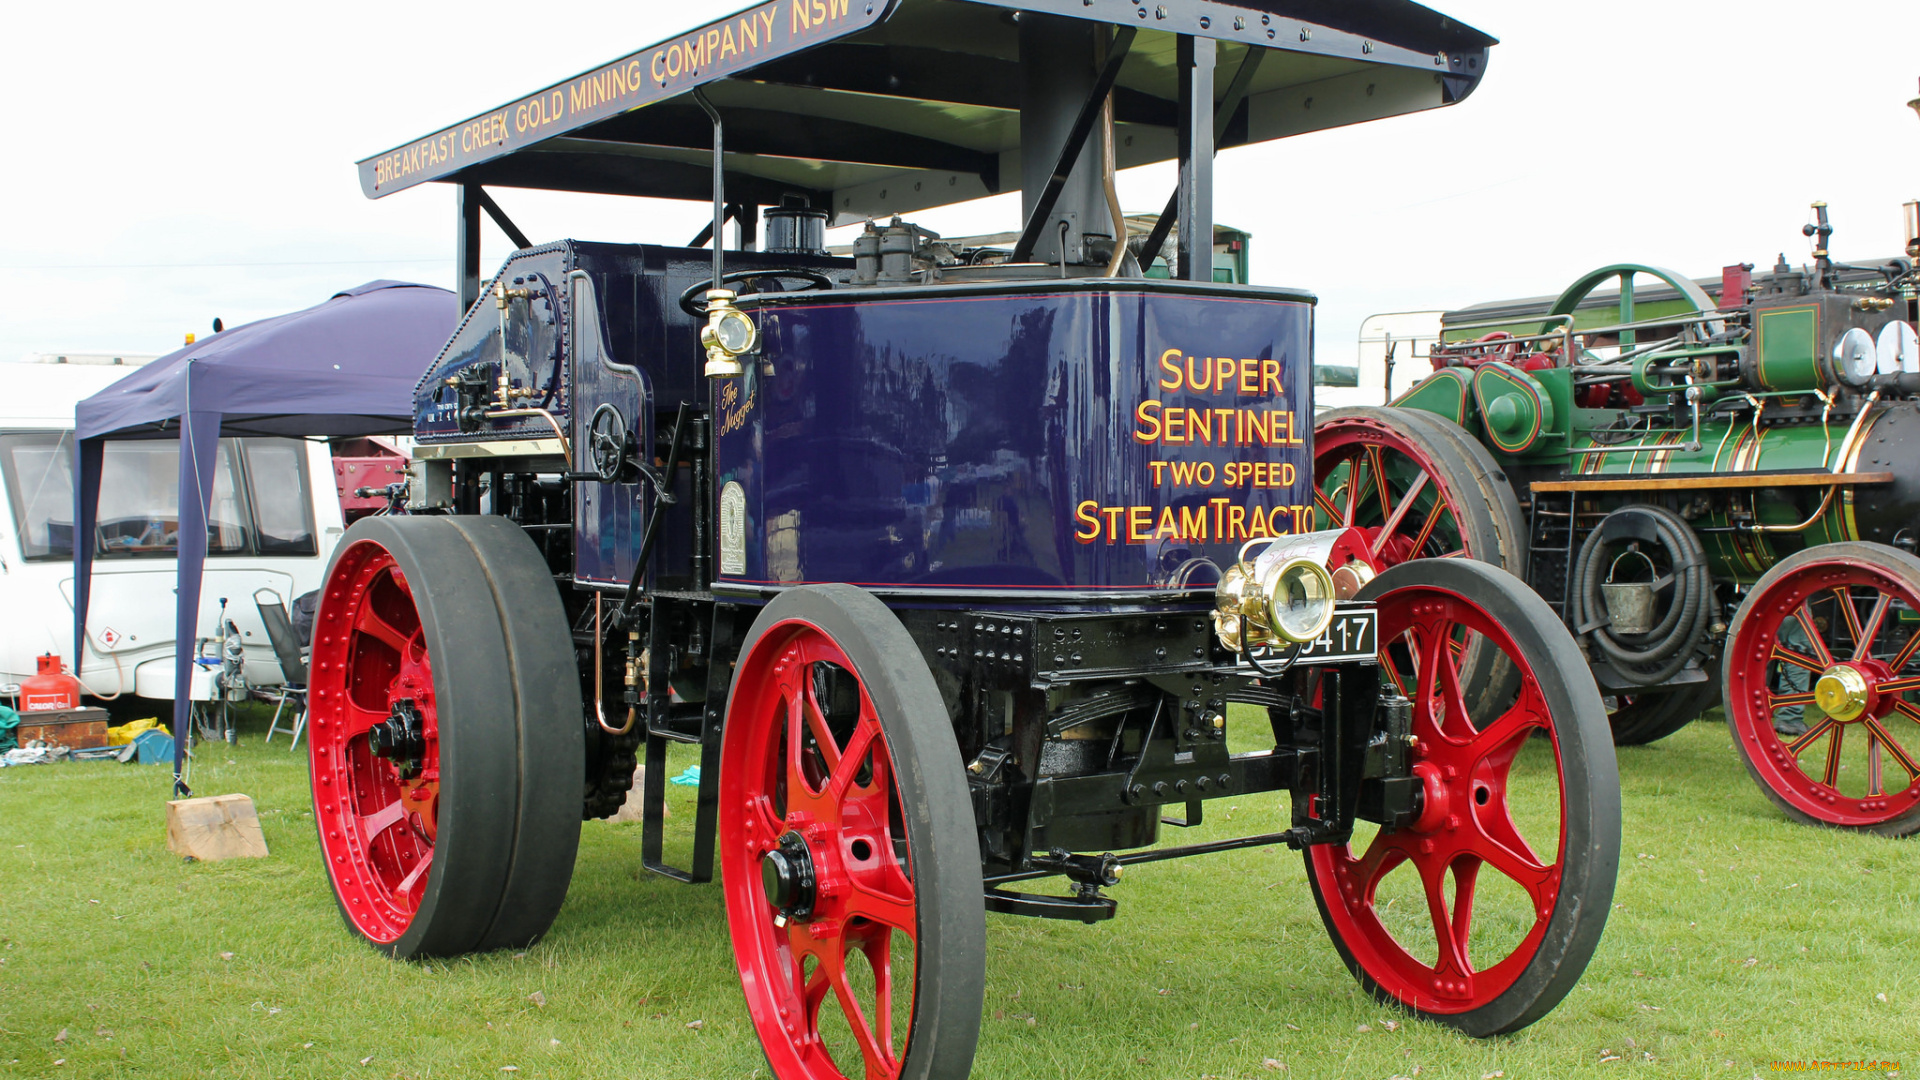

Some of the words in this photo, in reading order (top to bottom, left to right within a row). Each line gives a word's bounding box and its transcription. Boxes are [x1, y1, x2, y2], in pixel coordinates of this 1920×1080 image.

[376, 131, 457, 185] BREAKFAST
[462, 110, 510, 153] CREEK
[515, 90, 564, 133] GOLD
[569, 60, 641, 114] MINING
[651, 5, 778, 82] COMPANY
[721, 380, 738, 410] The
[1159, 348, 1285, 395] SUPER
[720, 389, 756, 437] Nugget
[1134, 399, 1304, 446] SENTINEL
[1149, 460, 1216, 487] TWO
[1223, 461, 1297, 488] SPEED
